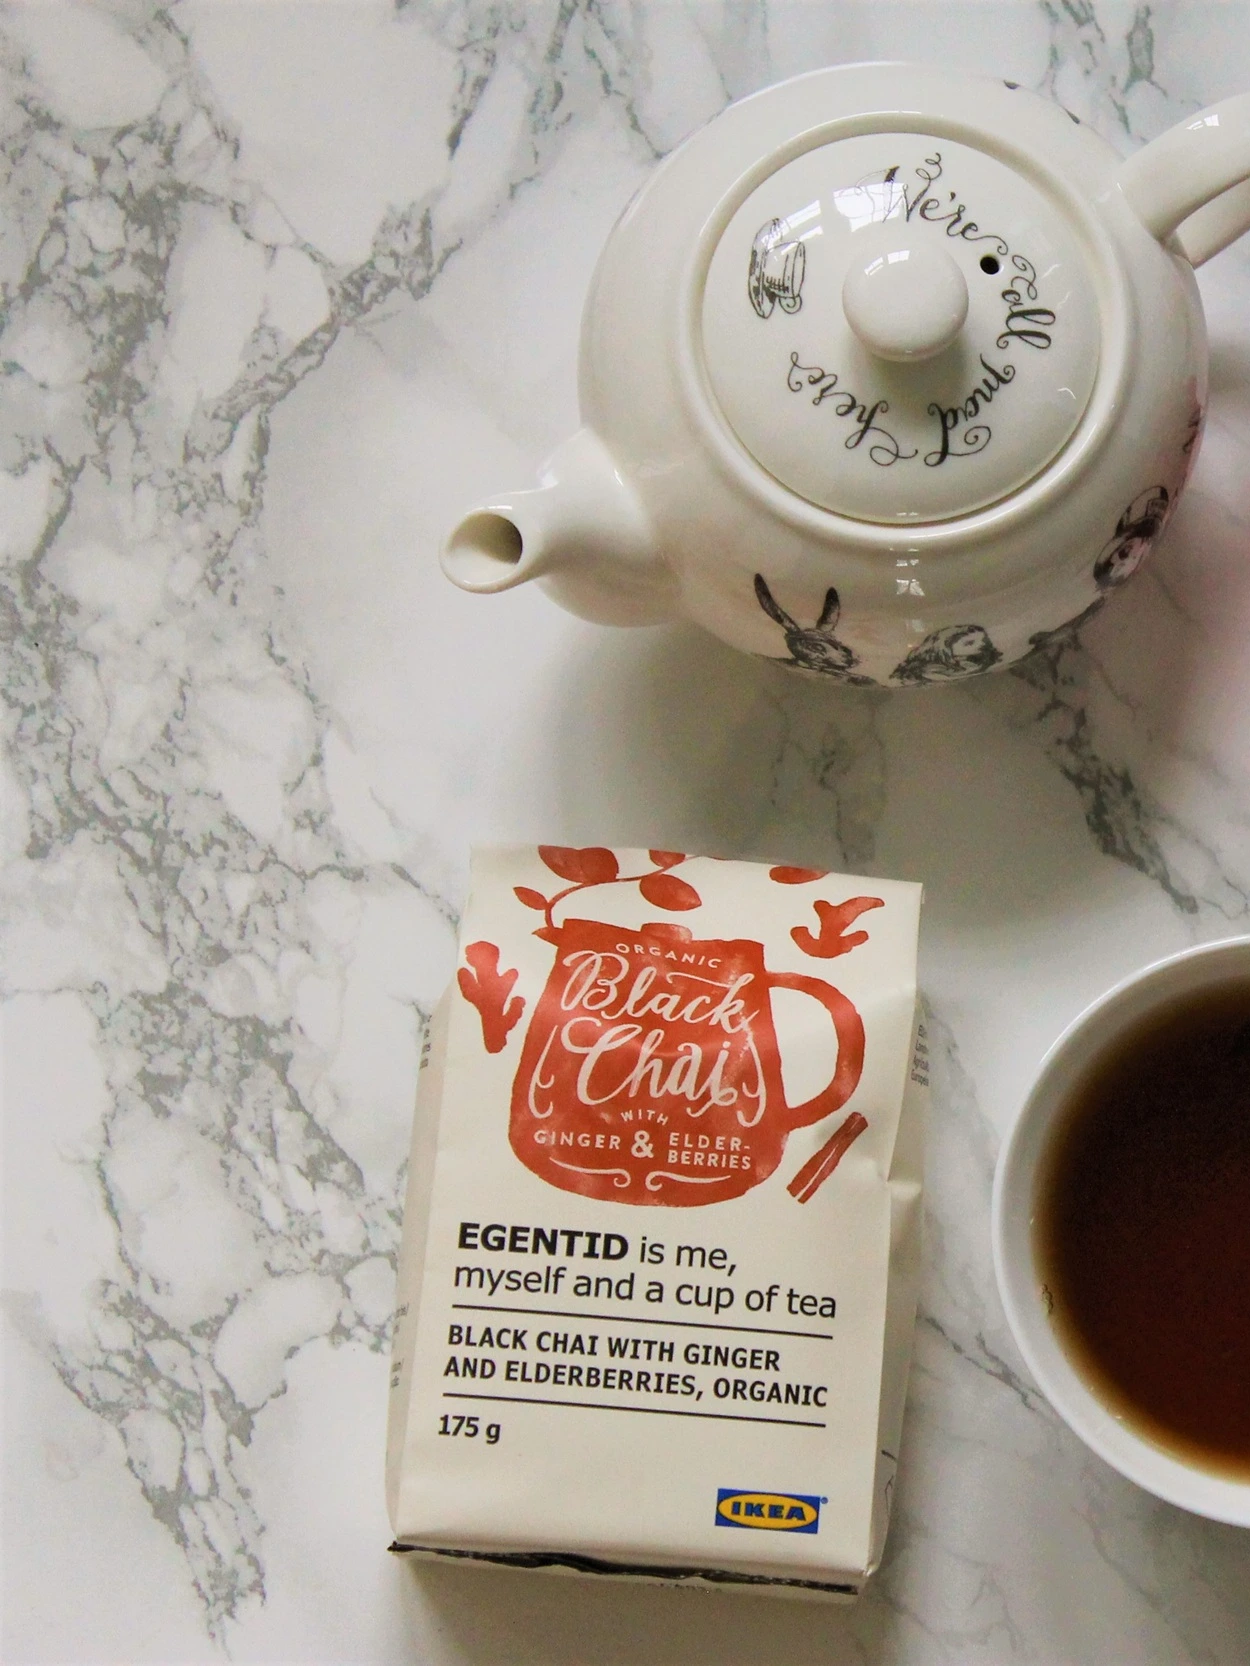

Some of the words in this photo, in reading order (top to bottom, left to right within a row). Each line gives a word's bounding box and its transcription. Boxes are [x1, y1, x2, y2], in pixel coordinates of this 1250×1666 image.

[853, 152, 1008, 256] We're
[996, 254, 1056, 350] all
[788, 351, 918, 467] here
[924, 353, 1016, 467] mad
[615, 943, 722, 969] ORGANIC
[562, 950, 760, 1034] Black
[560, 1016, 738, 1118] Chai
[620, 1109, 669, 1126] WITH
[533, 1129, 622, 1151] GINGER
[630, 1130, 655, 1159] &
[668, 1132, 751, 1152] ELDER-
[667, 1149, 752, 1170] BERRIES
[458, 1222, 629, 1261] EGENTID
[640, 1236, 665, 1265] is
[675, 1244, 737, 1277] me,
[453, 1266, 567, 1296] myself
[573, 1272, 635, 1301] and
[645, 1279, 664, 1303] a
[675, 1283, 735, 1315] cup
[745, 1284, 780, 1312] of
[786, 1288, 837, 1318] tea
[447, 1324, 528, 1351] BLACK
[536, 1331, 599, 1356] CHAI
[607, 1336, 675, 1363] WITH
[683, 1343, 781, 1372] GINGER
[443, 1356, 496, 1379] AND
[504, 1360, 703, 1401] ELDERBERRIES,
[713, 1377, 828, 1407] ORGANIC
[438, 1414, 480, 1438] 175
[485, 1422, 501, 1445] g
[731, 1500, 807, 1521] IKEA
